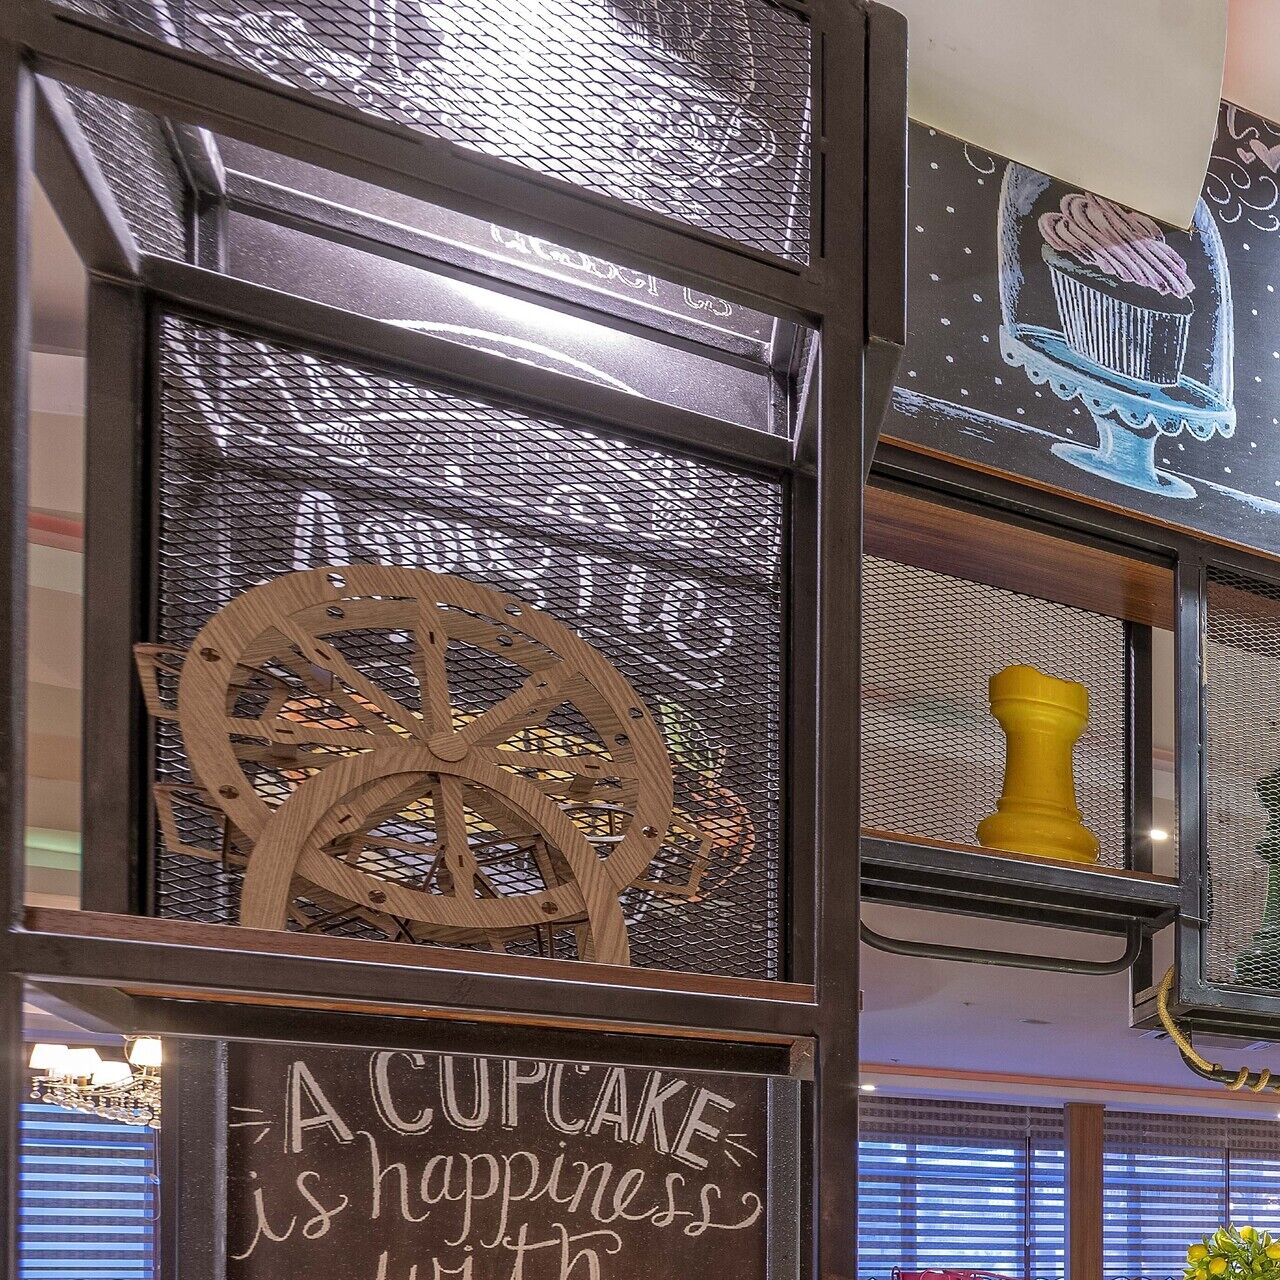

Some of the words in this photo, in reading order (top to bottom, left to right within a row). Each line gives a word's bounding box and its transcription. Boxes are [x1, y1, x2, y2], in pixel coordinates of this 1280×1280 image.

[283, 1059, 353, 1154] A
[369, 1050, 736, 1169] CUPCAKE
[231, 1169, 349, 1260] is
[356, 1129, 764, 1248] happiness
